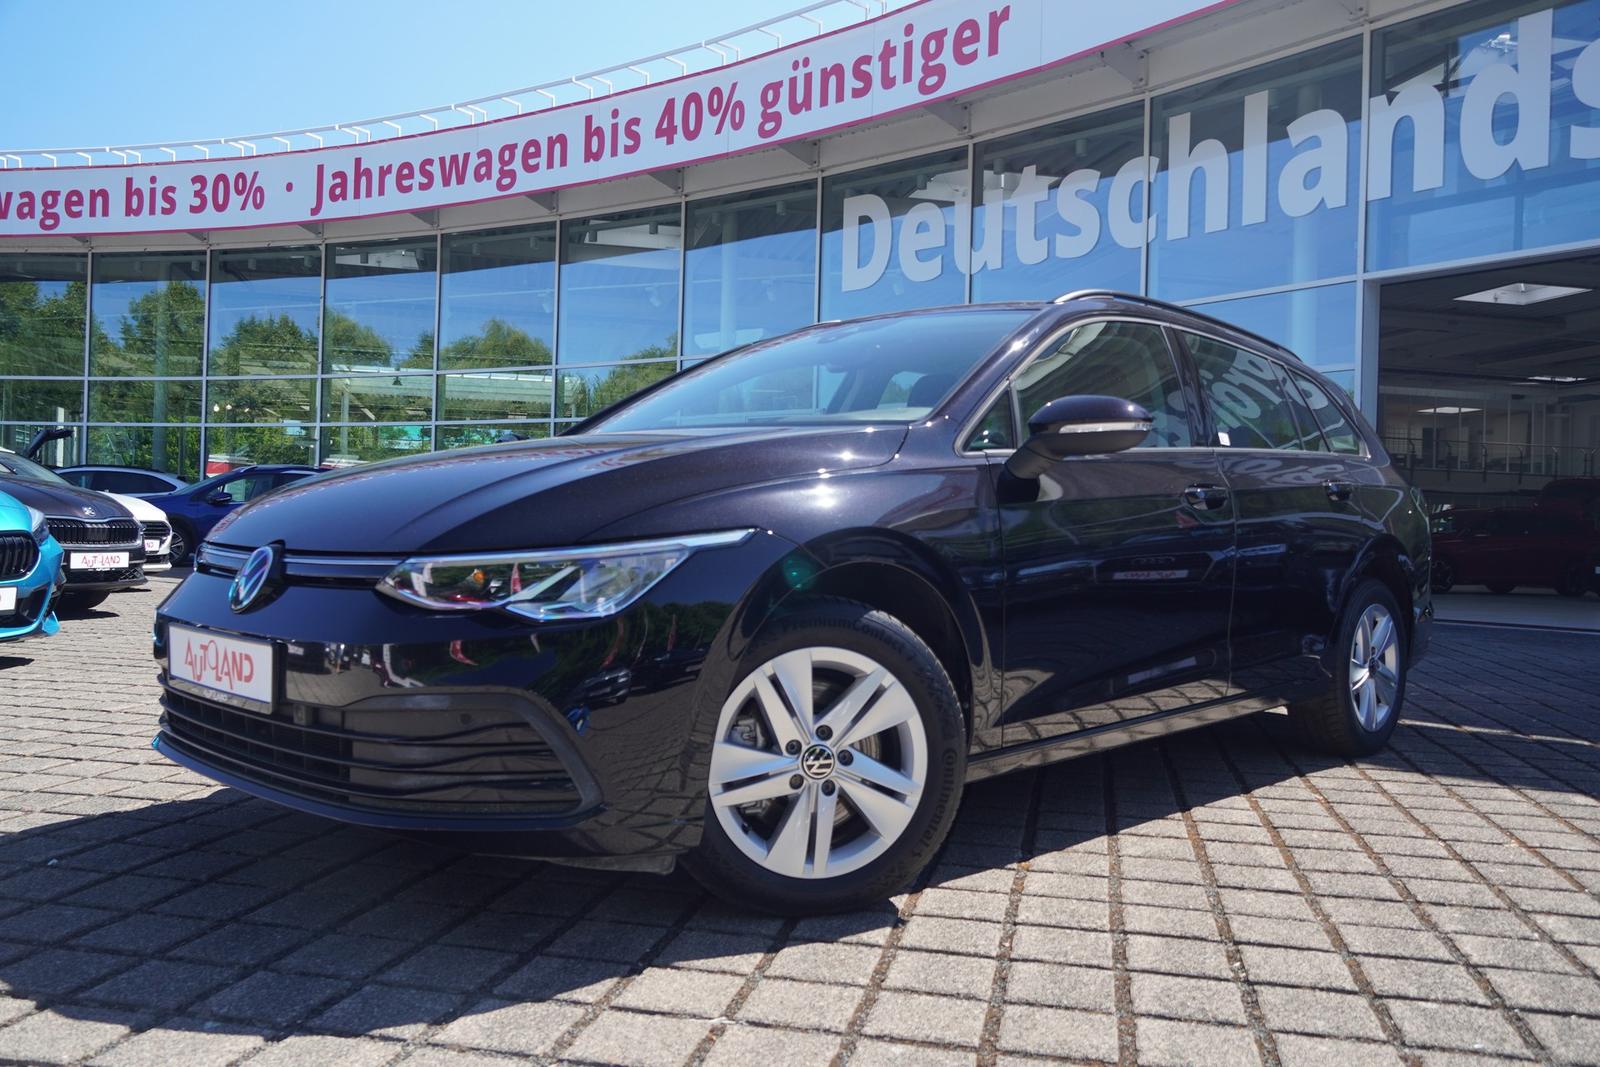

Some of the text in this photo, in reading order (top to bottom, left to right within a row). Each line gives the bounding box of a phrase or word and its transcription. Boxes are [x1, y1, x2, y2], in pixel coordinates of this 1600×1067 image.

[124, 175, 177, 217] bis
[189, 171, 265, 214] 30%
[310, 133, 568, 216] Jahreswagen
[584, 109, 641, 163] bis
[655, 83, 745, 145] 40%
[758, 7, 1010, 138] günstiger
[81, 555, 121, 568] AUTLAND
